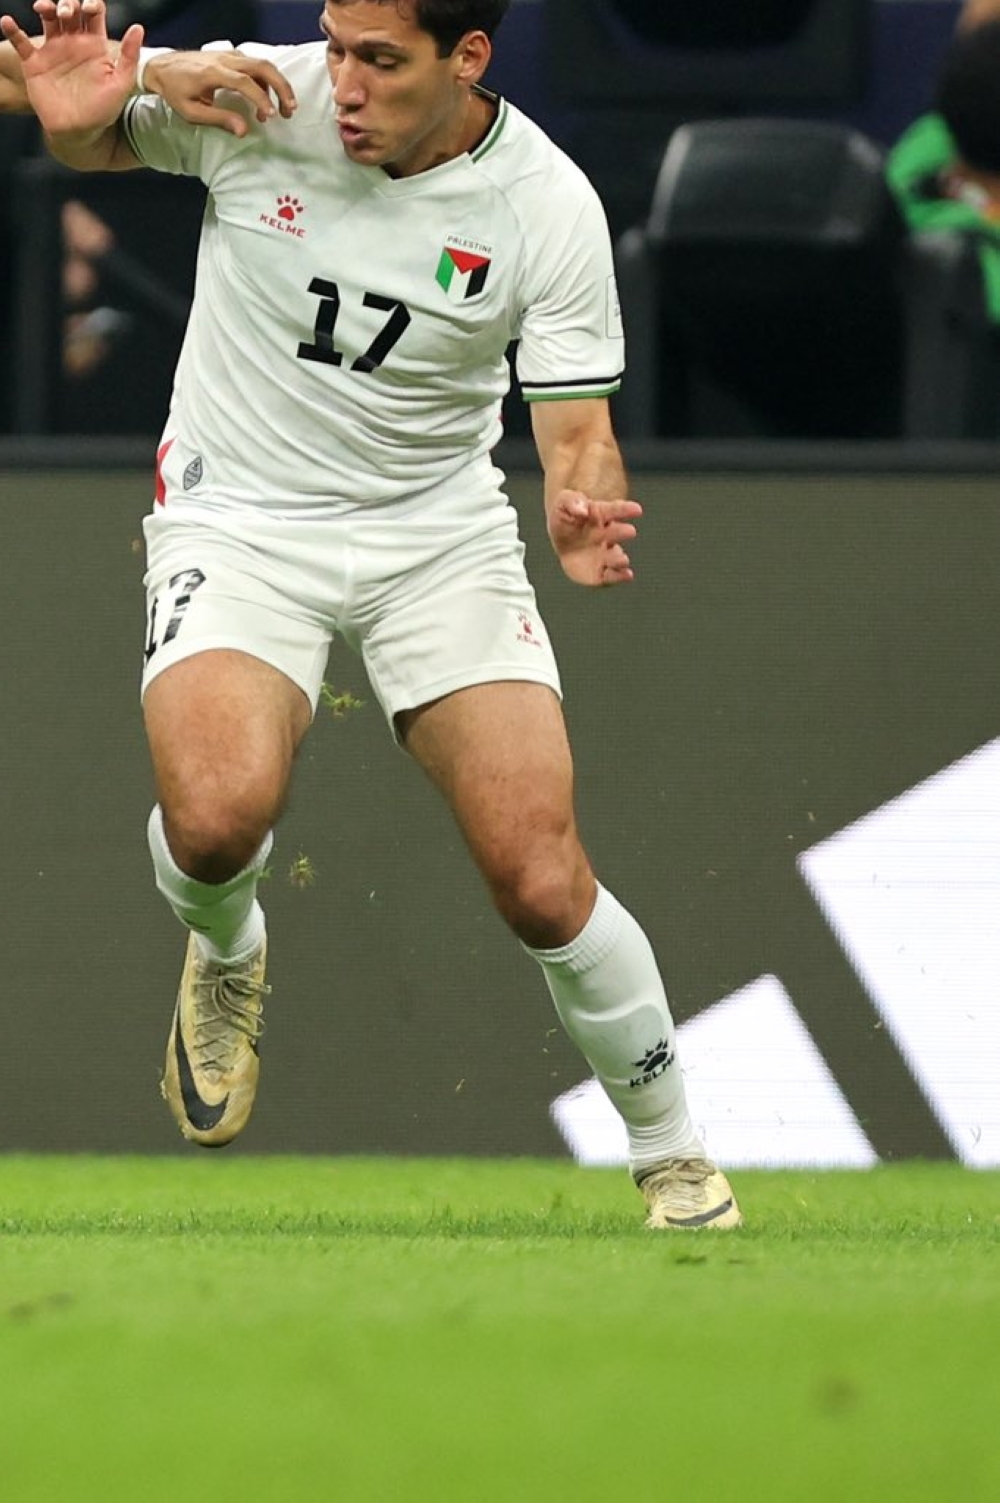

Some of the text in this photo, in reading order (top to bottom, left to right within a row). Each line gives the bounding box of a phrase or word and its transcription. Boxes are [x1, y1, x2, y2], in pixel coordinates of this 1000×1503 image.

[259, 213, 306, 239] KELME
[447, 235, 492, 254] PALESTINE
[296, 276, 411, 374] 17
